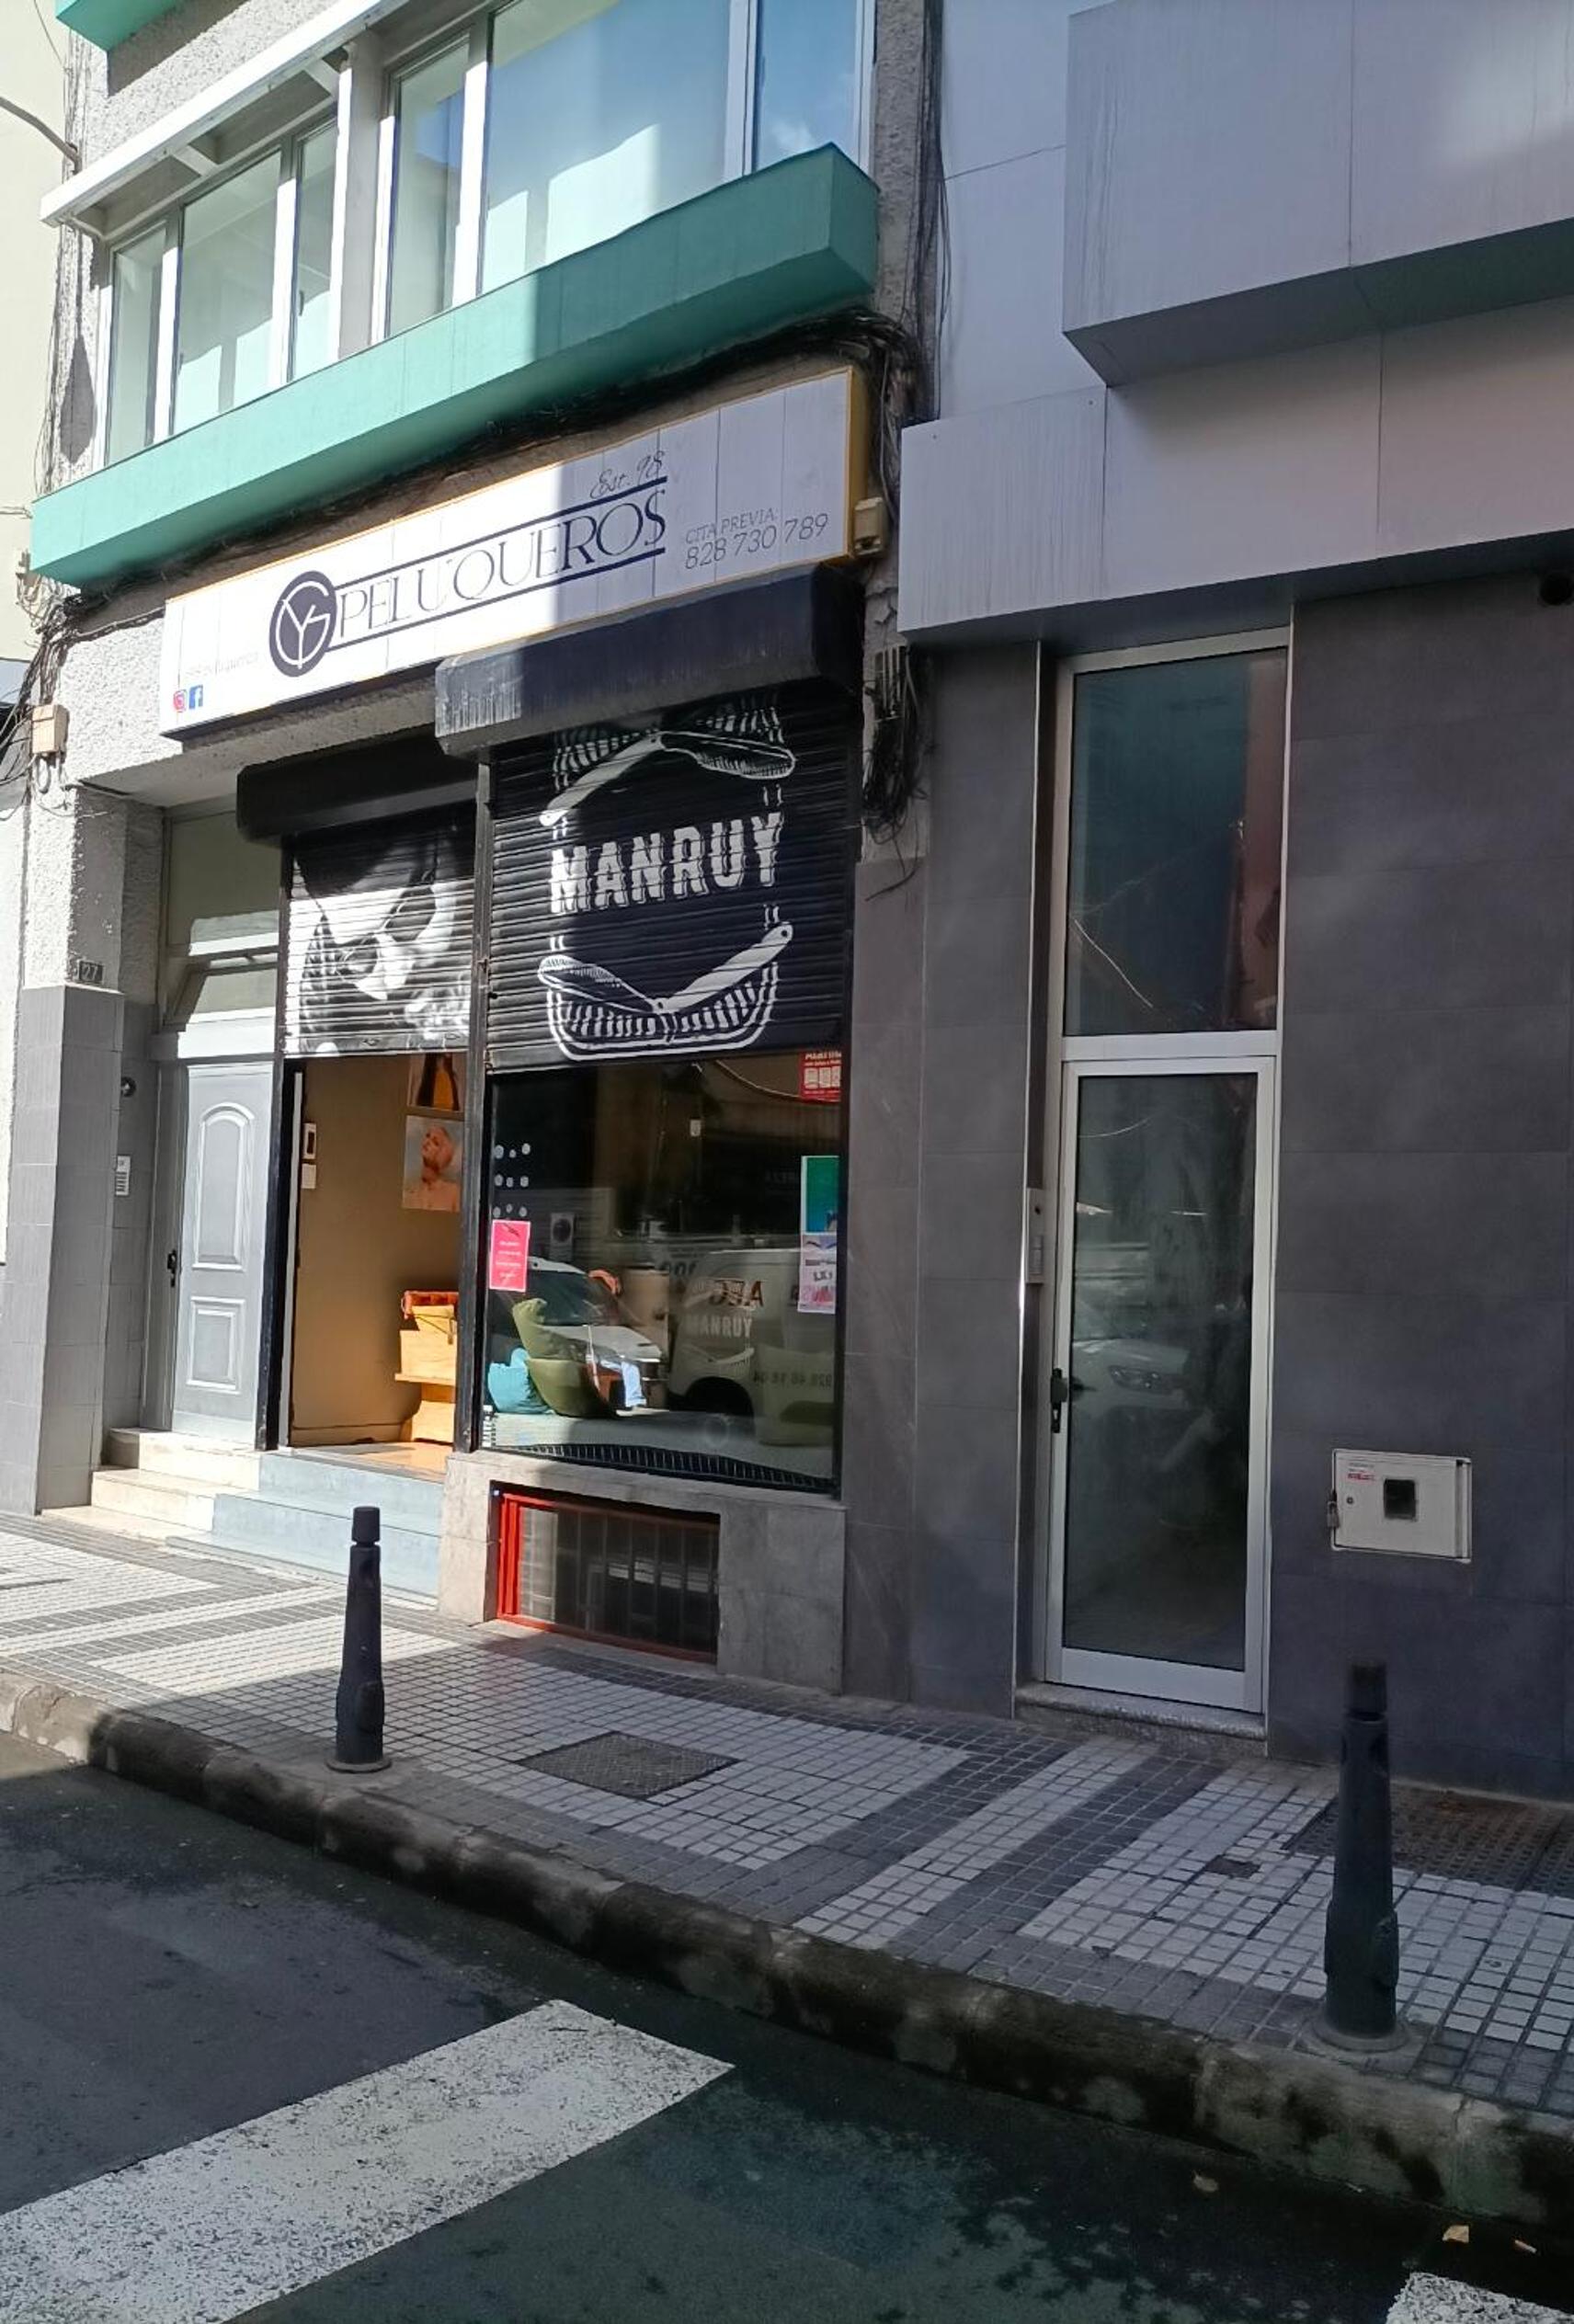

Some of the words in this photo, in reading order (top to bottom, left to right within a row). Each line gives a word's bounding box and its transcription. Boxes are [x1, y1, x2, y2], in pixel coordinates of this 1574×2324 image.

[339, 488, 666, 638] PELUQUEROS
[686, 523, 717, 544] CITA
[686, 538, 727, 569] 828
[735, 525, 777, 556] 730
[785, 513, 828, 543] 789
[550, 812, 784, 914] MANRUY
